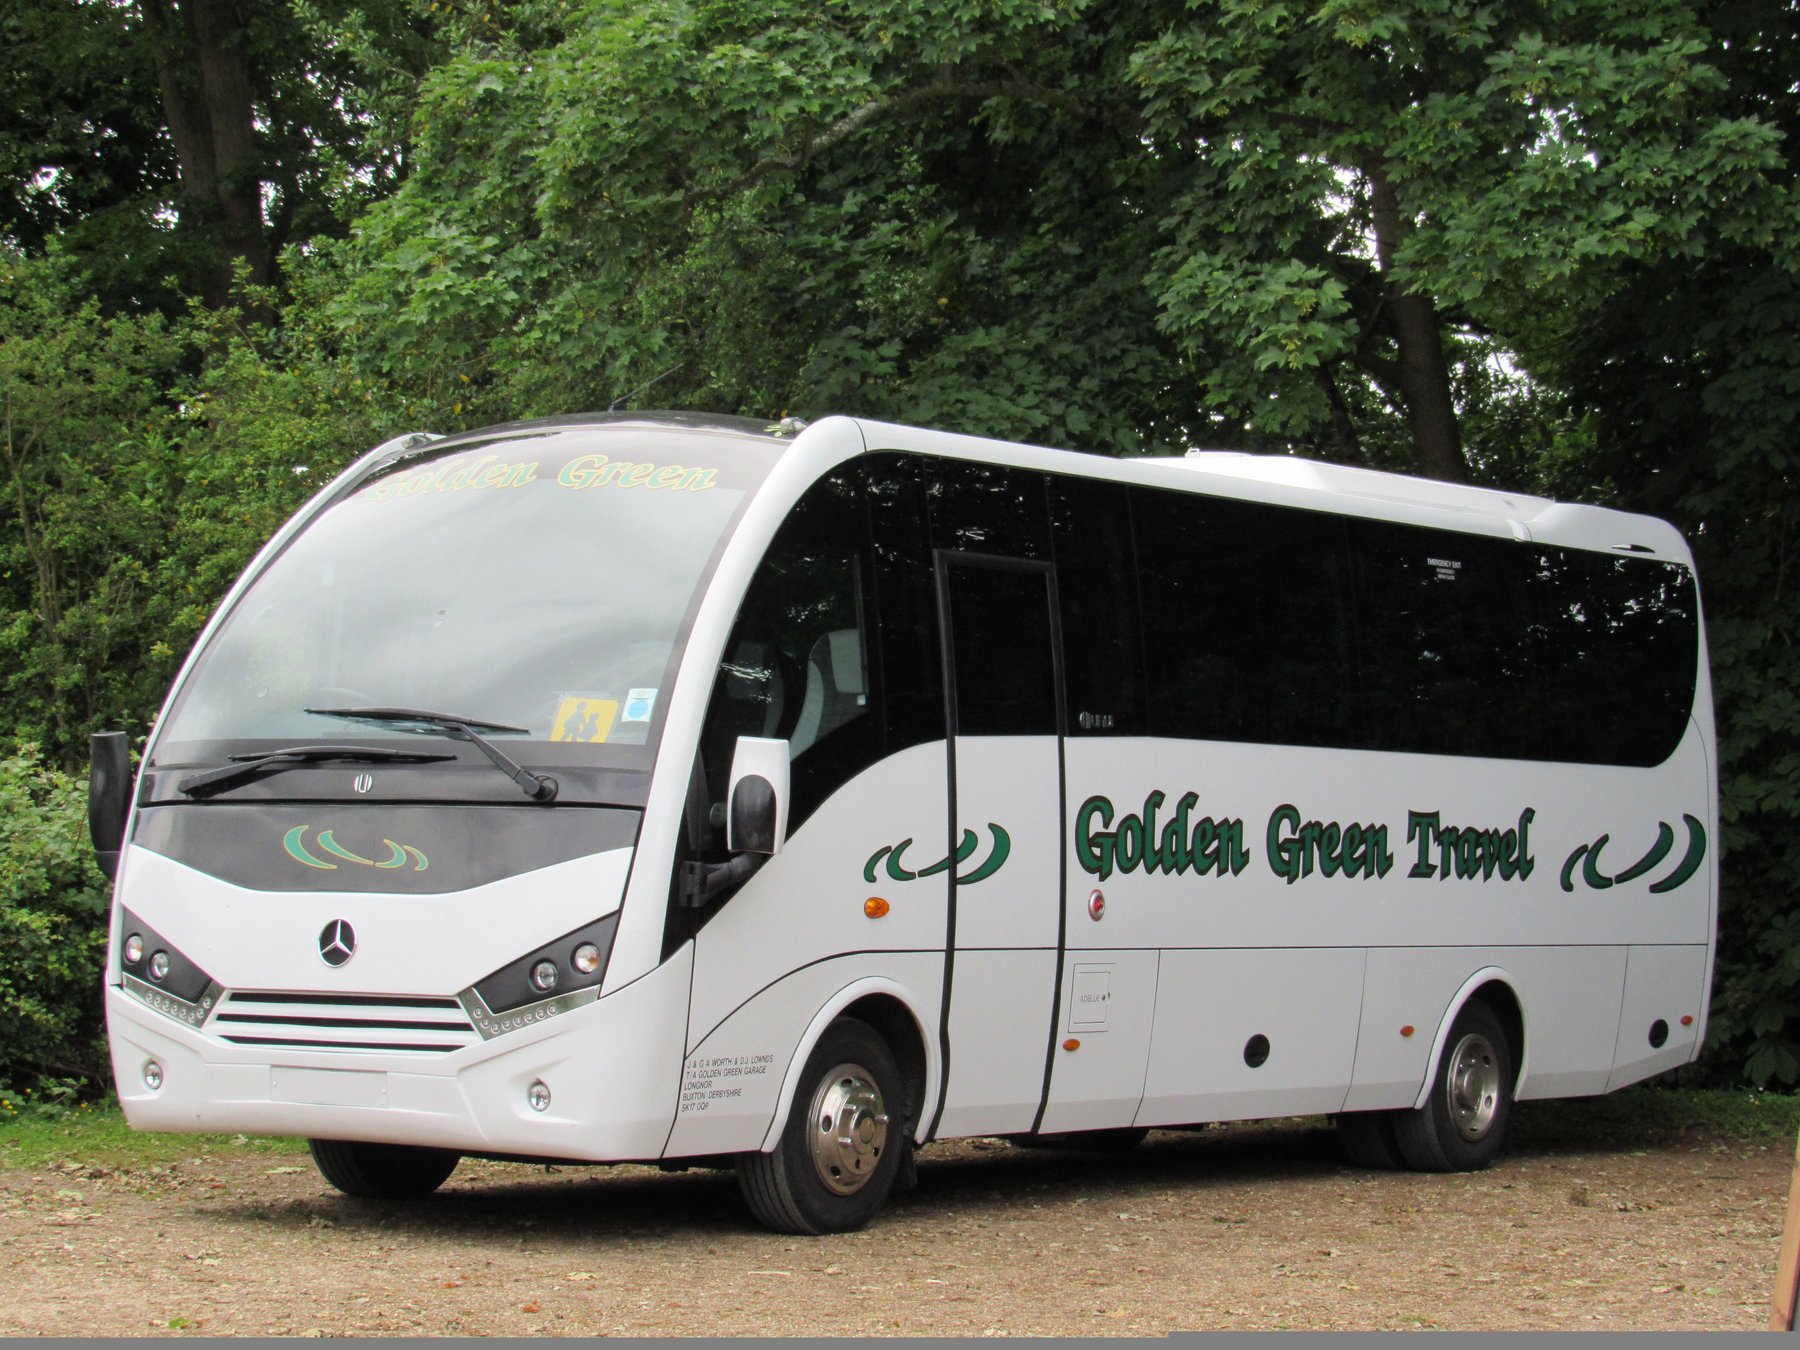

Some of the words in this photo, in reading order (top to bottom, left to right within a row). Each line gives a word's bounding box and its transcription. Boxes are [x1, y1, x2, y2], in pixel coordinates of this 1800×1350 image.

[364, 455, 540, 503] Golden
[557, 454, 718, 492] Green
[1427, 557, 1451, 567] EMERGENCY
[1075, 789, 1250, 882] Golden
[1266, 803, 1394, 885] Green
[1406, 806, 1536, 884] Travel
[1080, 994, 1100, 1002] ADBLUE
[712, 1057, 732, 1067] WORTH
[751, 1054, 774, 1063] LOWNDS
[698, 1069, 722, 1079] GOLDEN
[723, 1067, 742, 1077] GREEN
[743, 1065, 767, 1075] GARAGE
[684, 1080, 712, 1090] LONGNOR
[708, 1088, 742, 1099] DERBYSHIRE
[681, 1103, 696, 1112] SK17
